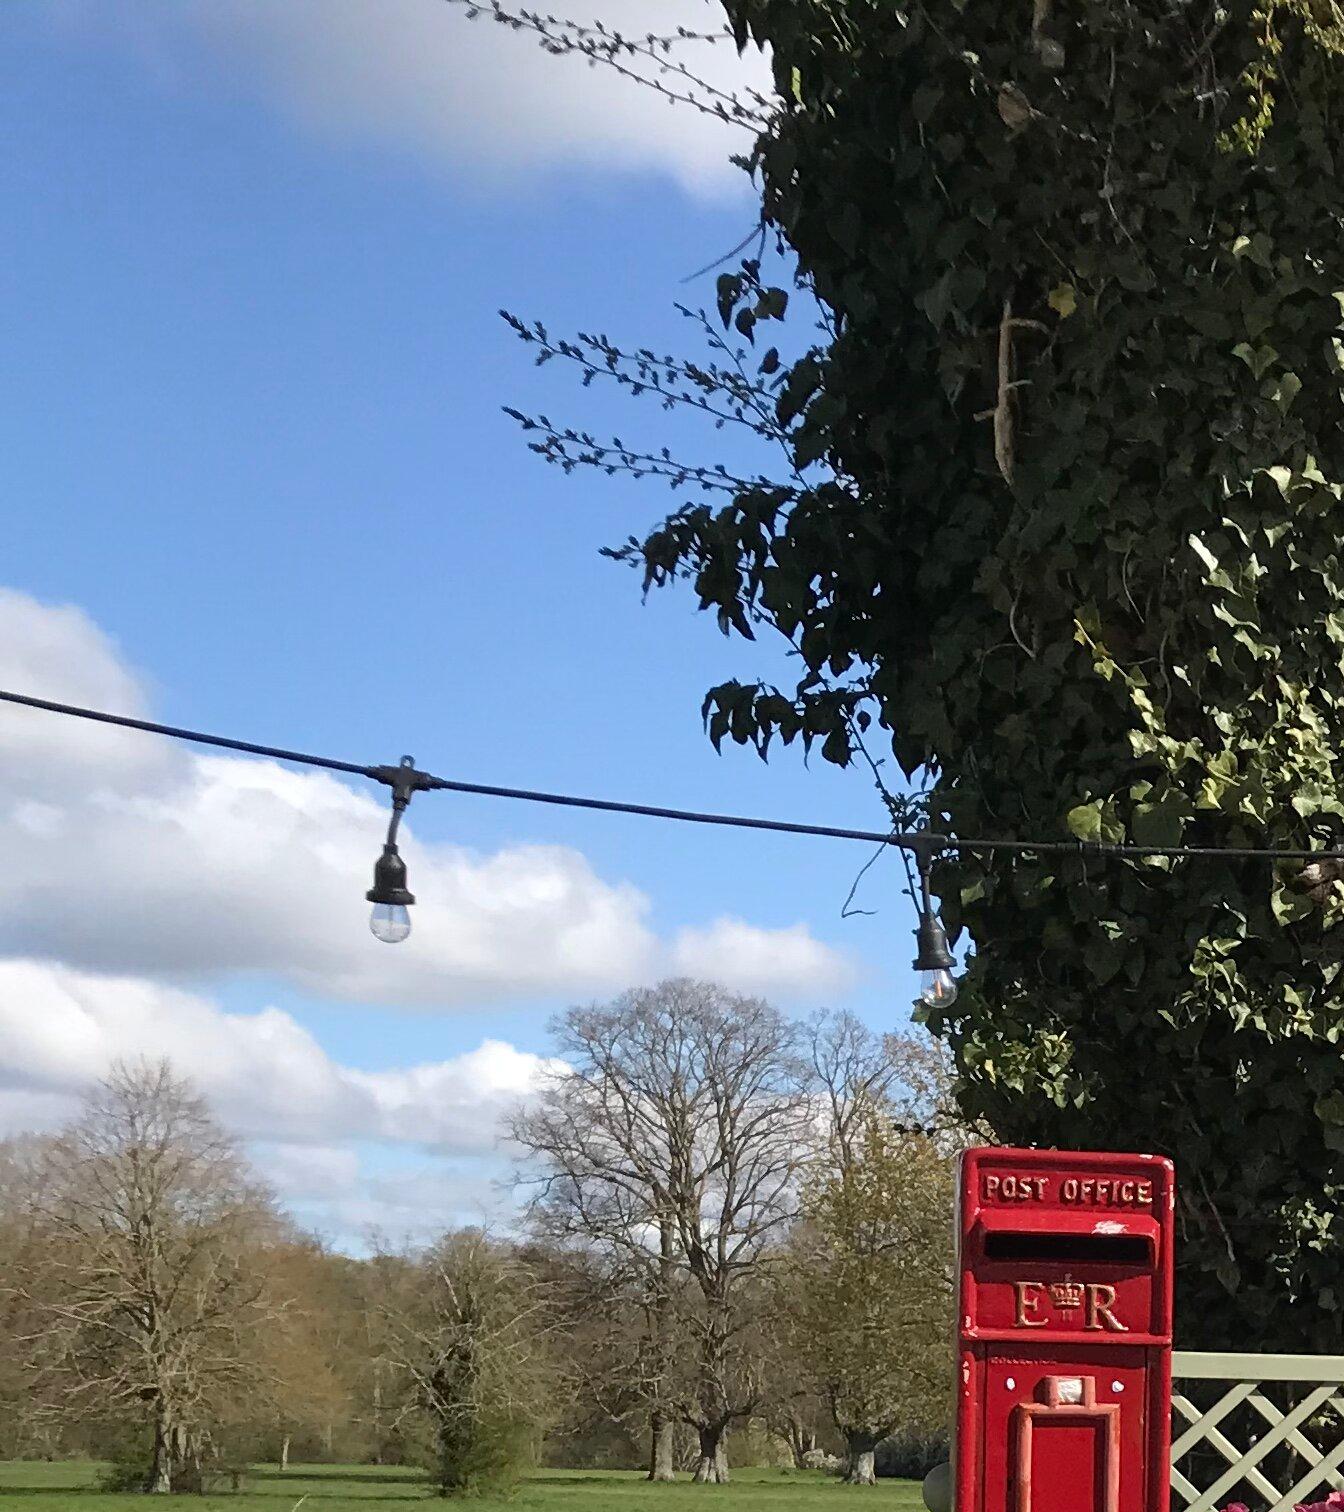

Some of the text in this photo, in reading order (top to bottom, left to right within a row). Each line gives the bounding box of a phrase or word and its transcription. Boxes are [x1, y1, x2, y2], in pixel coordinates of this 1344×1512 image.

[985, 1175, 1153, 1204] POST OFFICE
[1012, 1280, 1049, 1328] E
[1084, 1282, 1130, 1331] R
